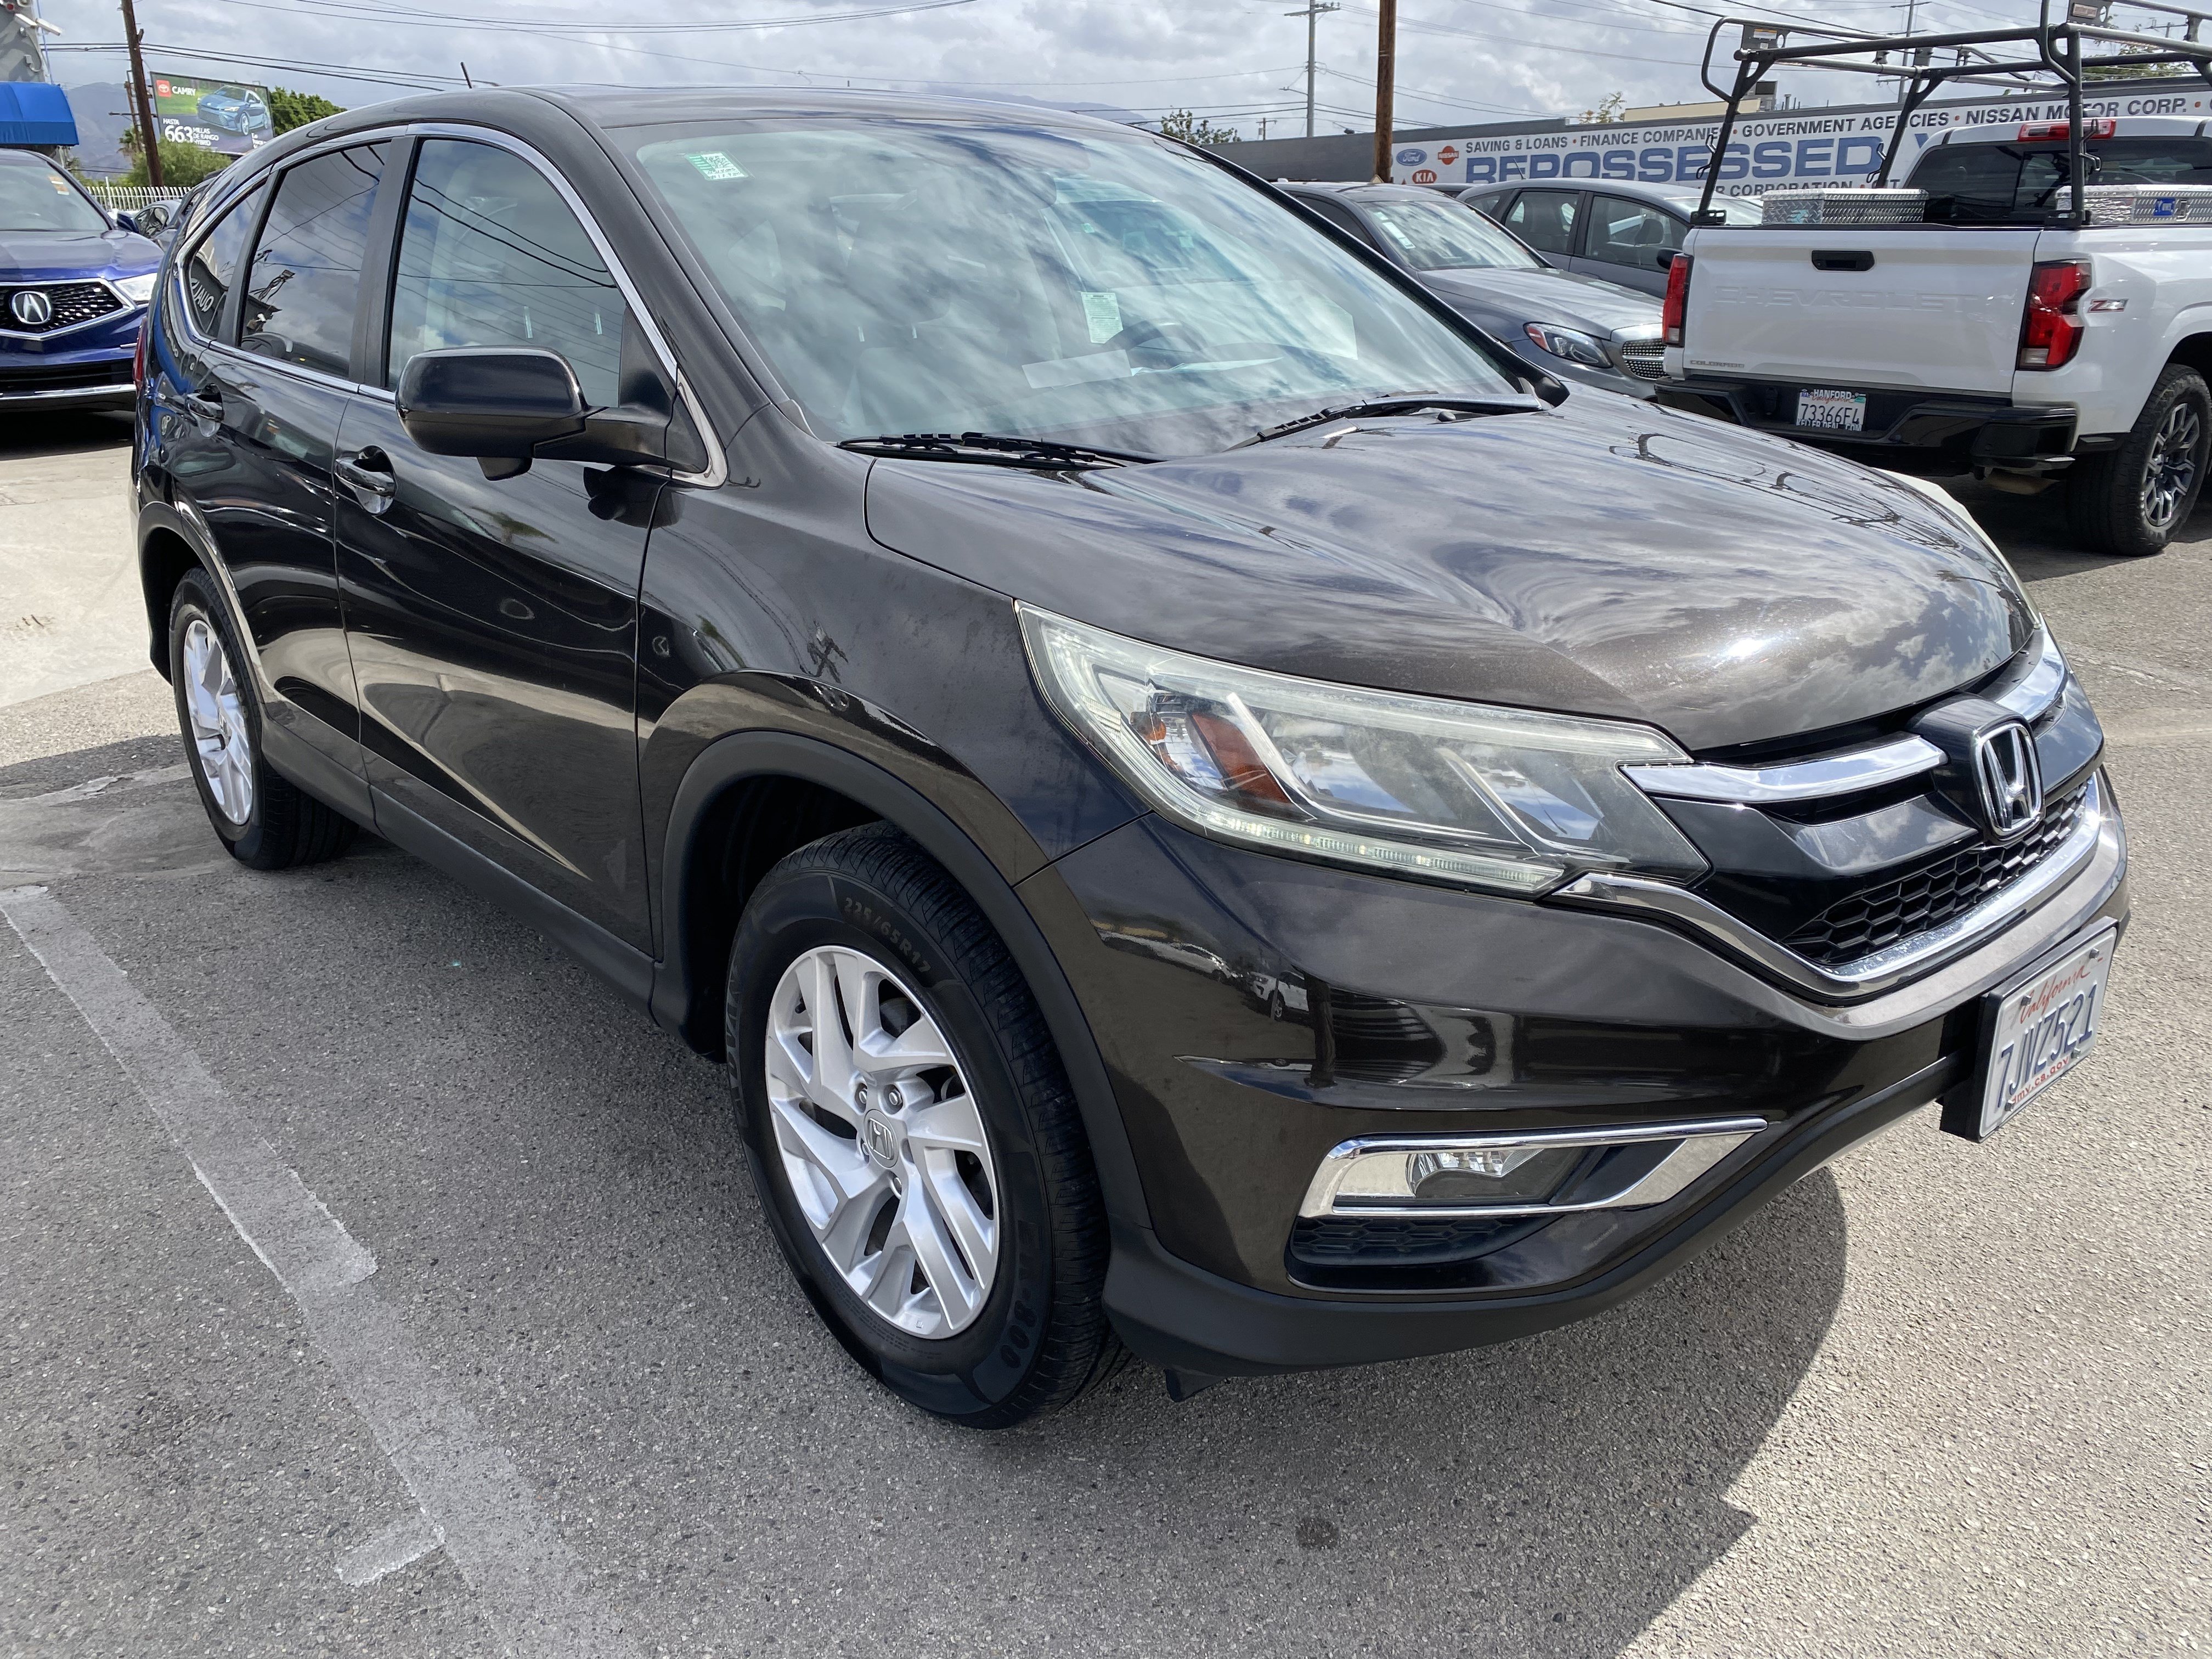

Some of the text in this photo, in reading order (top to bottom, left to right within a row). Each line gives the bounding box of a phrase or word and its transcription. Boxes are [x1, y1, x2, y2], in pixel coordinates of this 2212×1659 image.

[172, 86, 196, 97] CAMRY
[1966, 107, 2040, 125] NISSAN
[2128, 98, 2187, 115] CORP.
[165, 125, 194, 143] 663
[1742, 112, 1950, 138] GOVERNMENT AGECIES
[1466, 127, 1724, 154] SAVING & LOANS FINANCE COMPANIE
[1402, 151, 1421, 163] Ford
[1465, 136, 1884, 184] REPOSSESSED
[1415, 172, 1434, 183] KIA
[1690, 359, 1745, 368] COLORADO
[1814, 389, 1852, 399] HANFORD
[1997, 981, 2097, 1108] 7JVZ521
